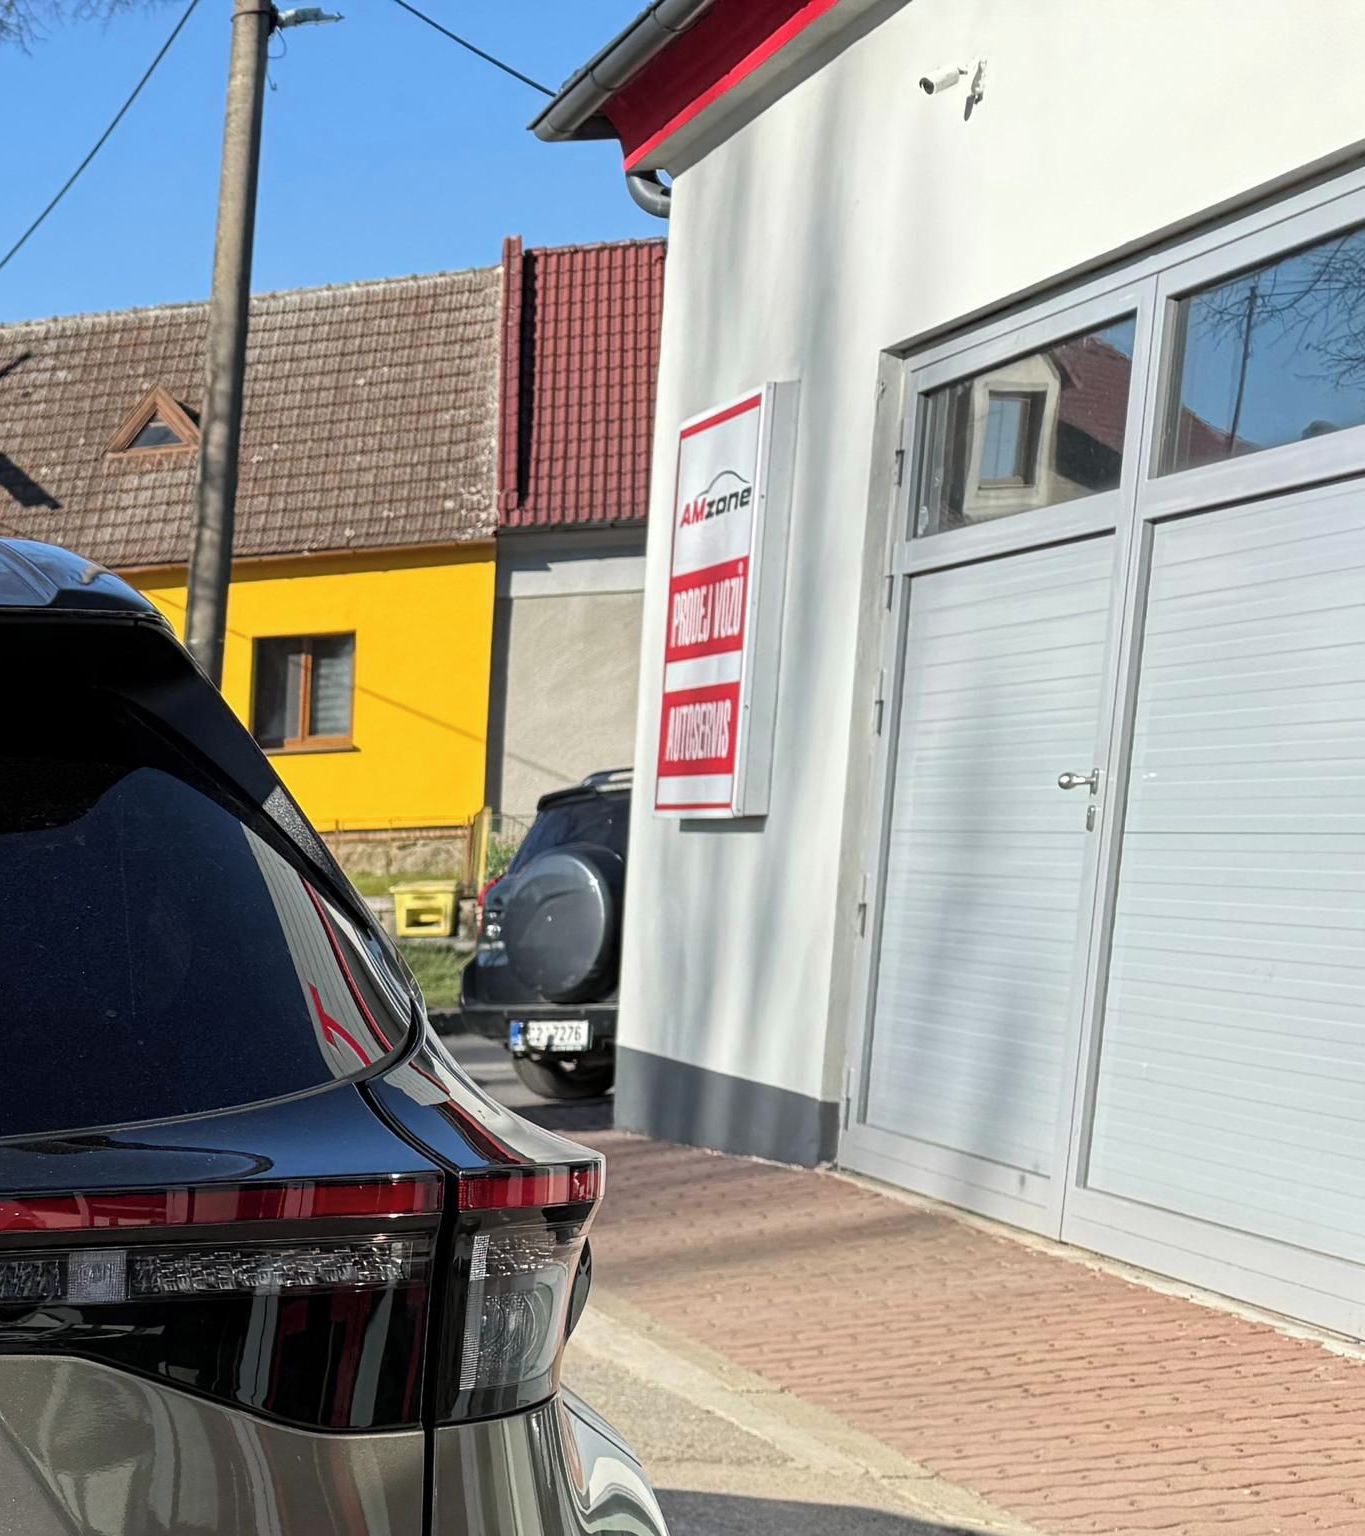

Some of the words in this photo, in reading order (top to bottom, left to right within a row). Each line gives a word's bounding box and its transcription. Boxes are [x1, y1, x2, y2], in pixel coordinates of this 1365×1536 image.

[679, 486, 752, 528] AMzone
[670, 583, 713, 648] PRODEJ
[713, 561, 744, 639] VOZŮ
[665, 698, 732, 762] AUTOSERVIS
